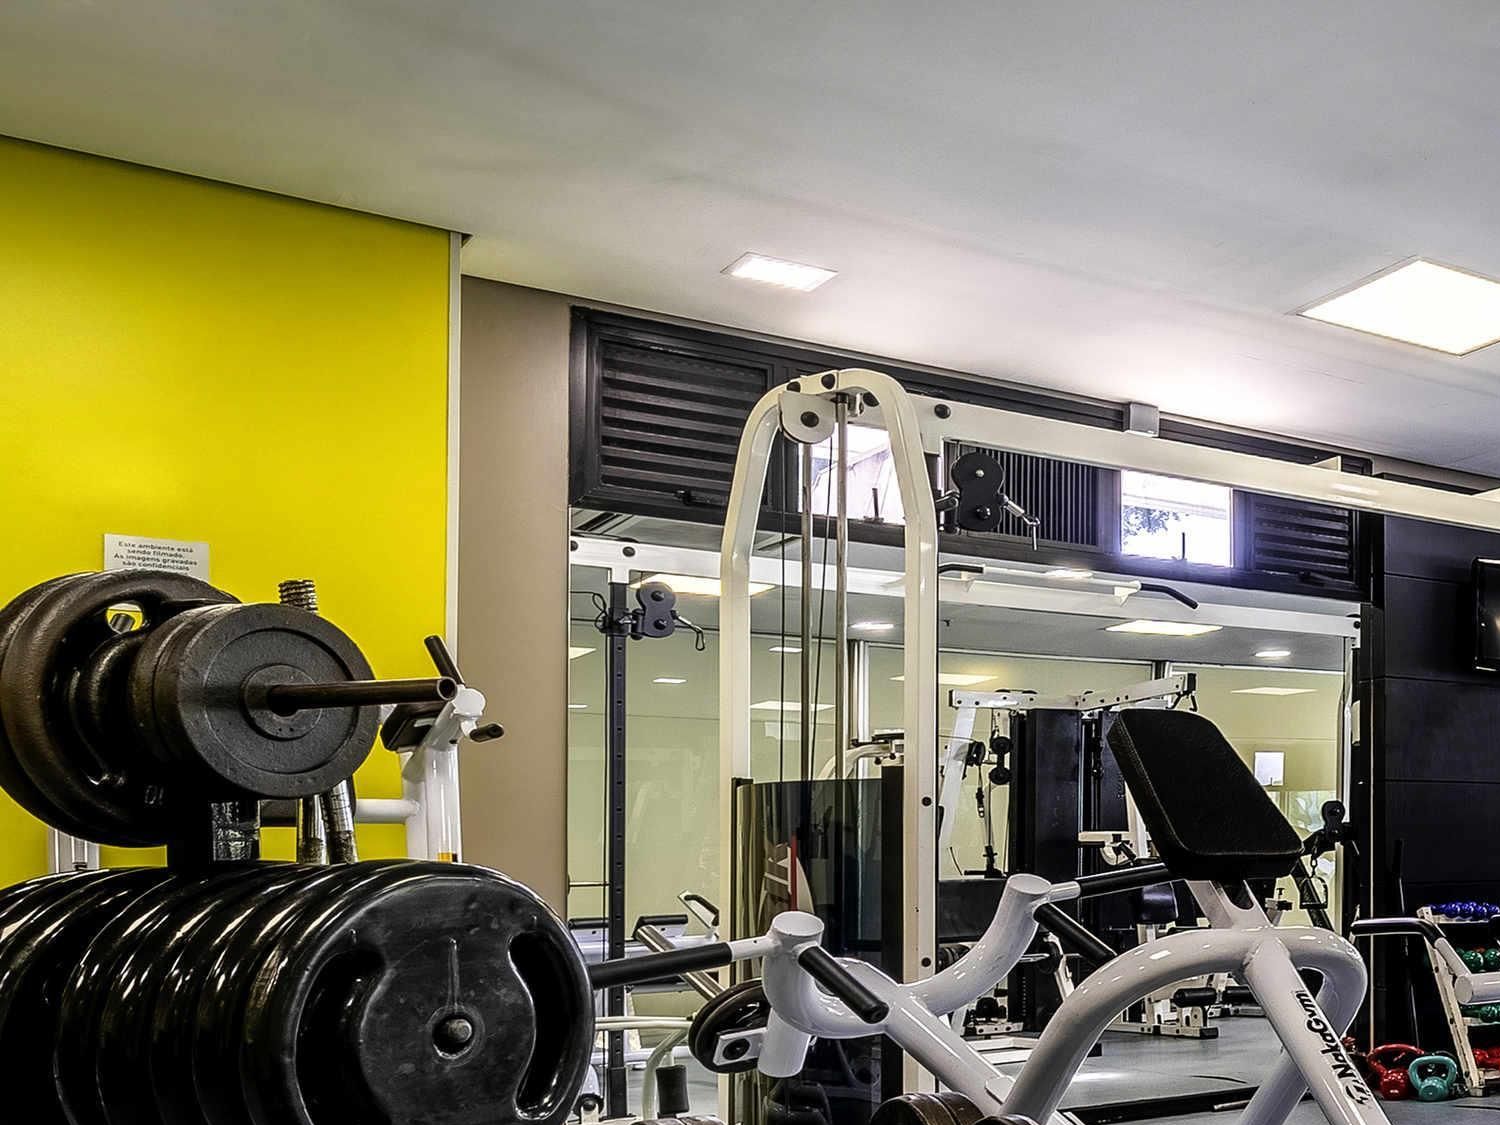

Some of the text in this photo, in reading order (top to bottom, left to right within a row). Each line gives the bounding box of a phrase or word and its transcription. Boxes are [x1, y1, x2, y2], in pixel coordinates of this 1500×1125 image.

[138, 543, 175, 551] ambiente
[177, 545, 194, 553] está
[126, 554, 160, 563] imagens
[162, 558, 197, 566] gravadas
[138, 561, 190, 571] confidenciais
[1295, 990, 1357, 1079] NakaGym
